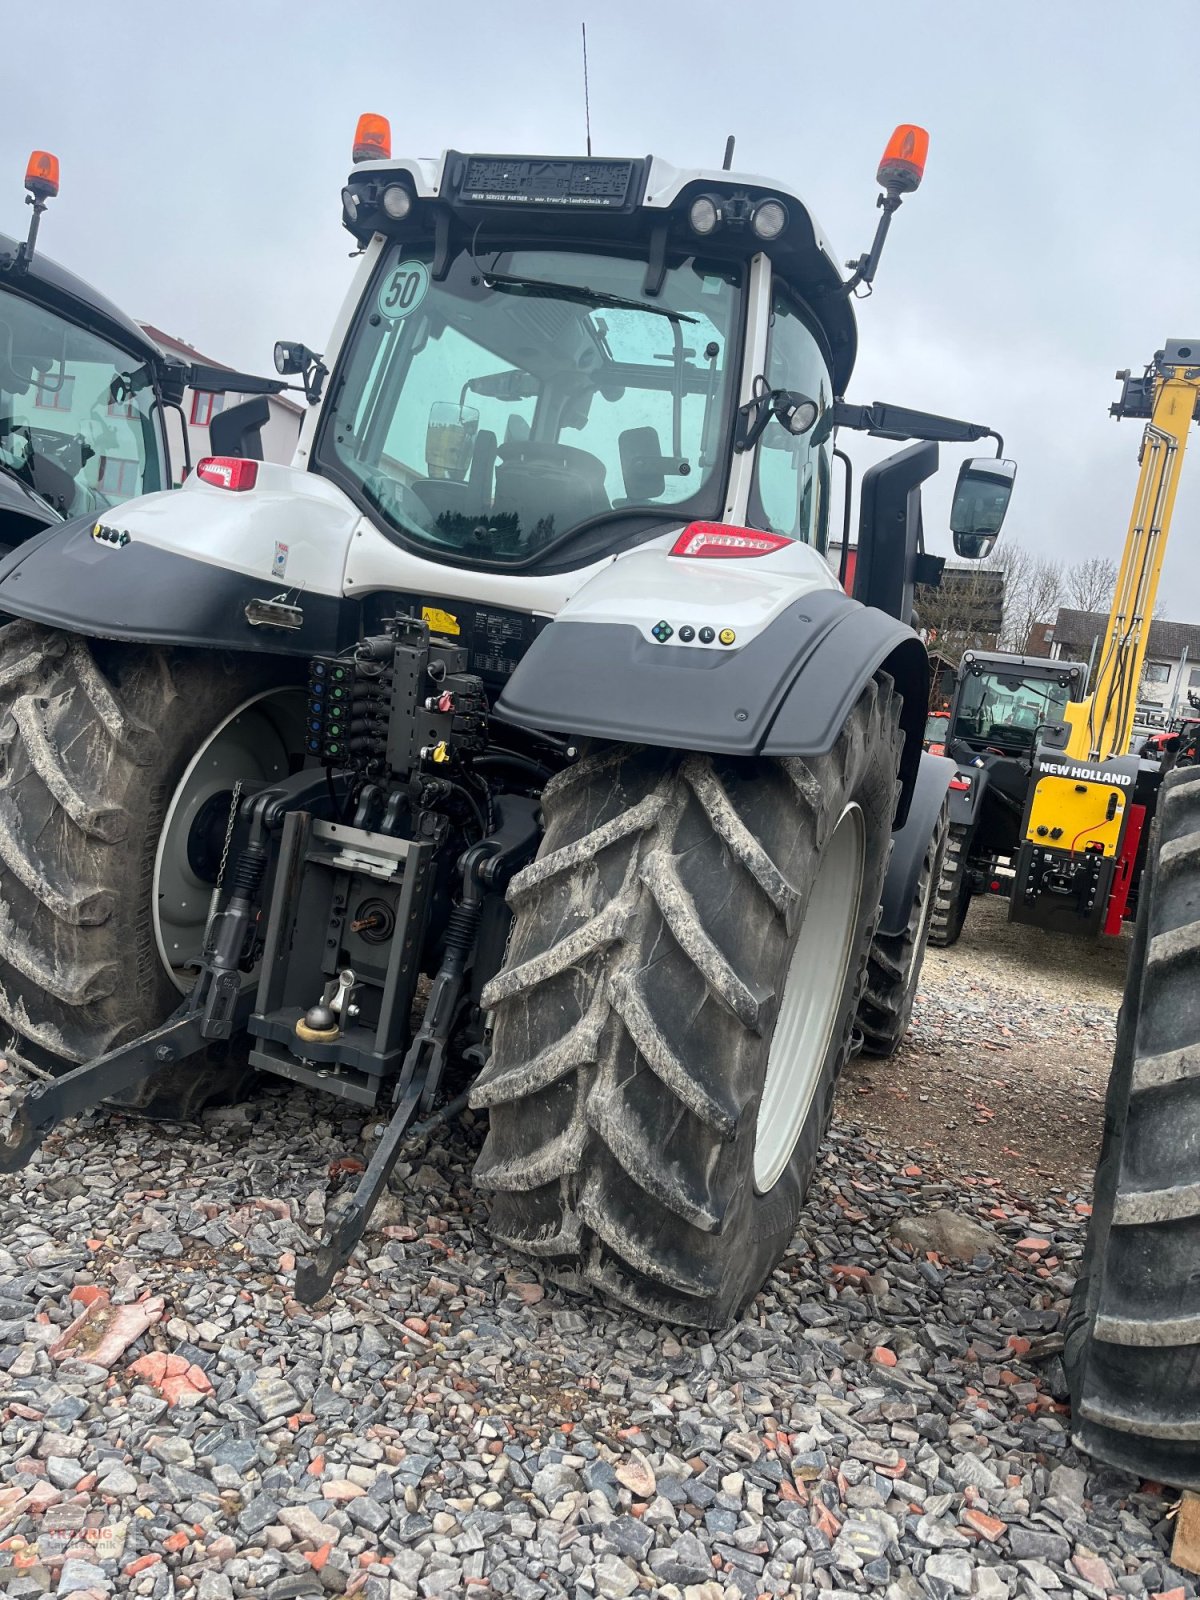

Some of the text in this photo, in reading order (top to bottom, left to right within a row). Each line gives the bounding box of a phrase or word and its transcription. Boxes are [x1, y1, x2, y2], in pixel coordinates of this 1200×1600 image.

[486, 194, 506, 202] SERVICE
[507, 194, 528, 202] PARTNER
[534, 195, 611, 205] www.traurig-landtechnik.de
[385, 271, 421, 309] 50
[1039, 762, 1132, 786] NEW HOLLAND
